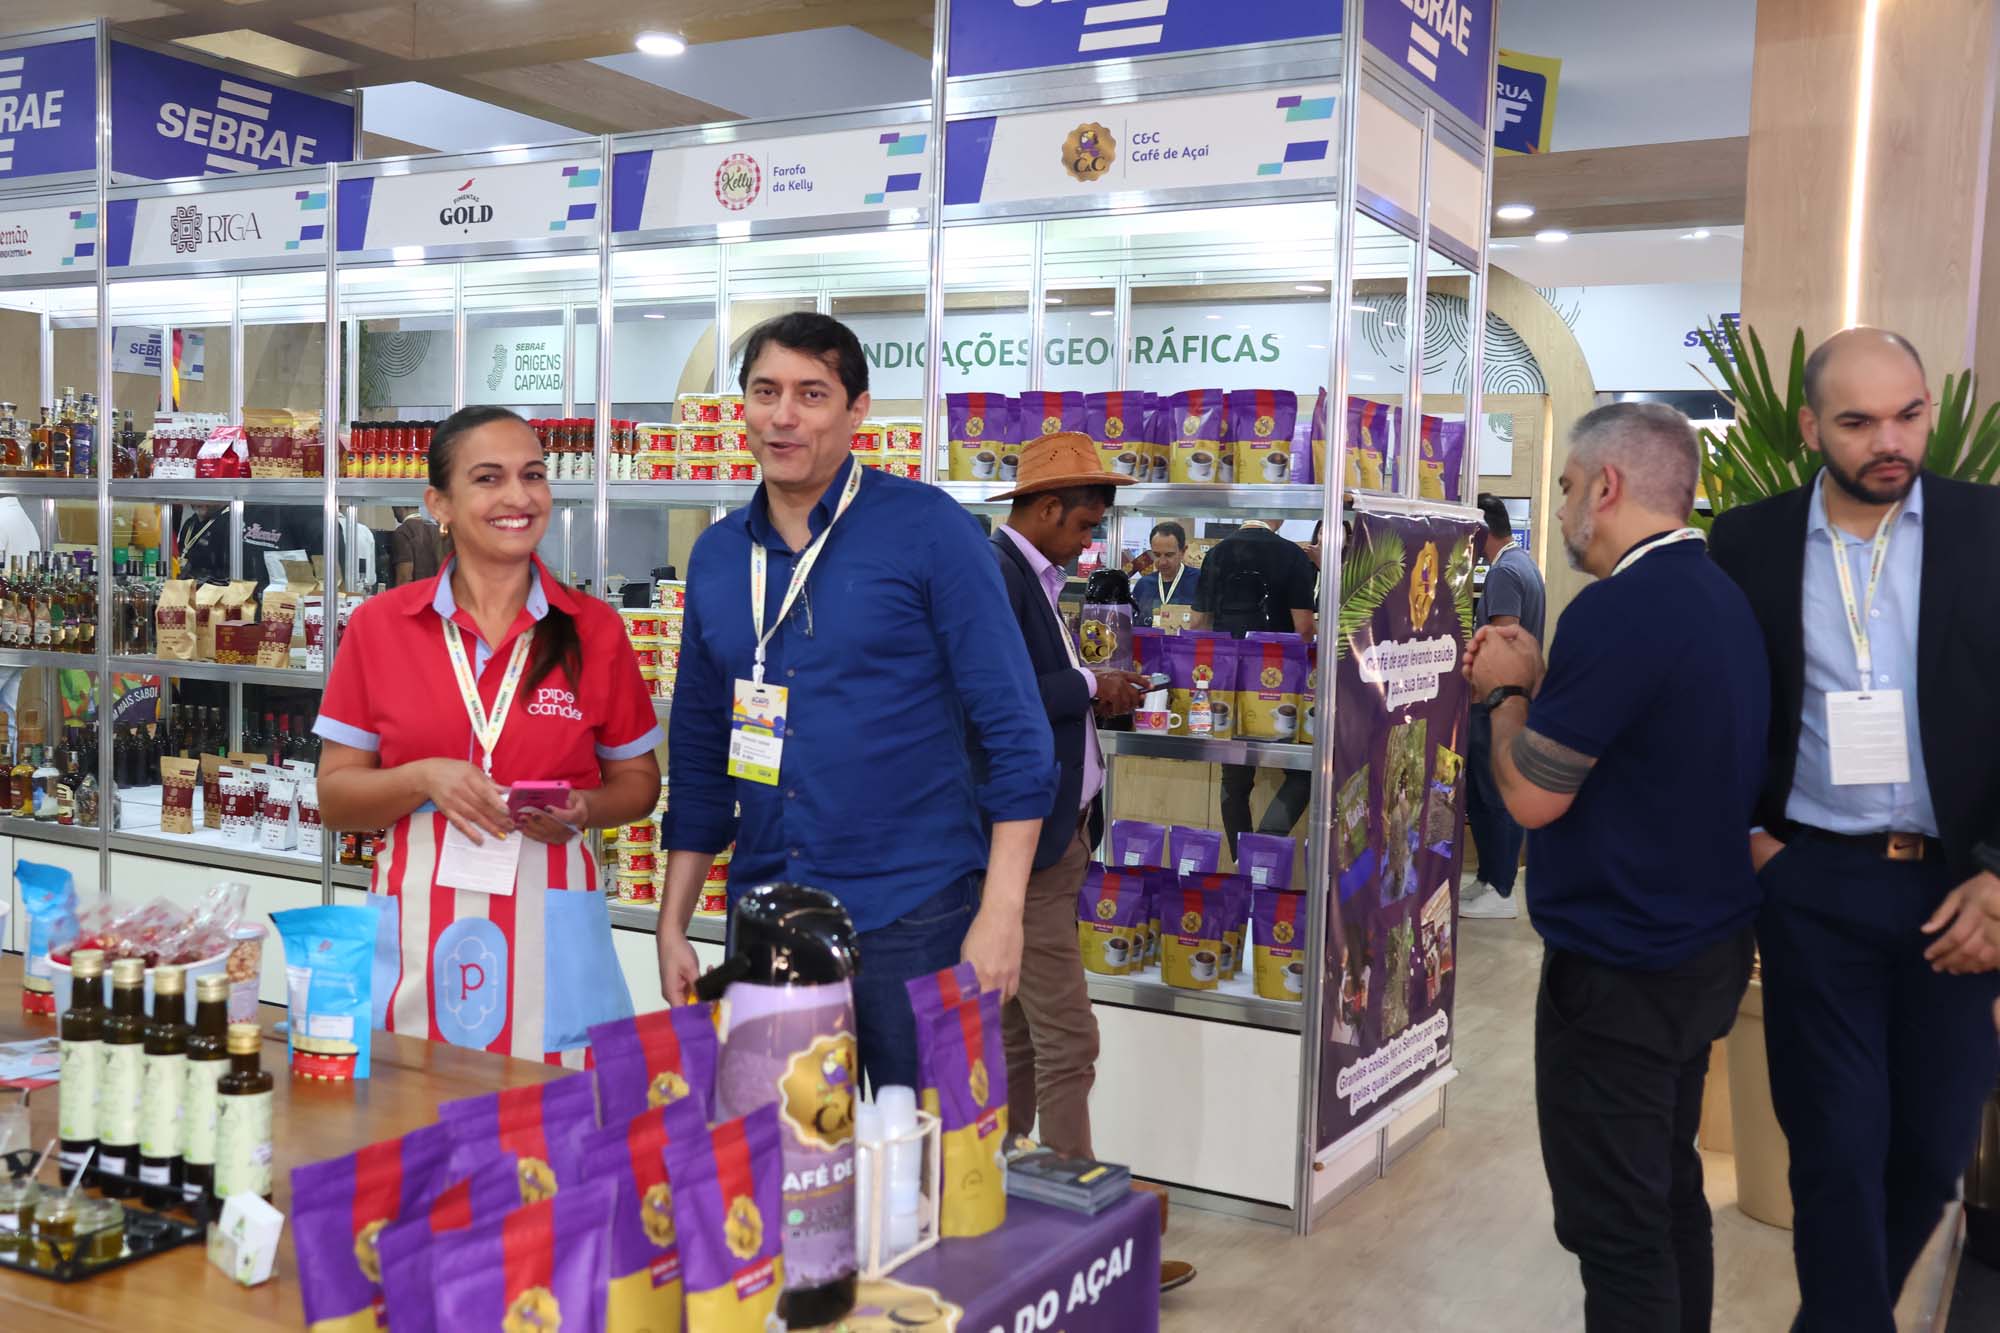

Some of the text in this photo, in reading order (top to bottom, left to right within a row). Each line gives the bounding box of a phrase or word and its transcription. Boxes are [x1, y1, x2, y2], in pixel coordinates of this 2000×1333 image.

[1496, 82, 1533, 102] RUA
[1495, 98, 1528, 132] F
[156, 102, 317, 167] SEBRAE
[1133, 132, 1160, 145] C&C
[1132, 149, 1160, 162] Café
[1163, 149, 1178, 160] de
[773, 163, 806, 177] Farofa
[721, 172, 753, 194] Kelly
[772, 179, 813, 193] da Kelly
[440, 204, 493, 226] GOLD
[515, 342, 546, 352] SEBRAE
[862, 332, 1029, 375] NDICAÇÕES
[515, 353, 561, 371] ORIGENS
[538, 688, 575, 704] pipe
[459, 963, 486, 1000] p
[782, 1164, 829, 1192] AFÉ
[1014, 1289, 1060, 1333] DO
